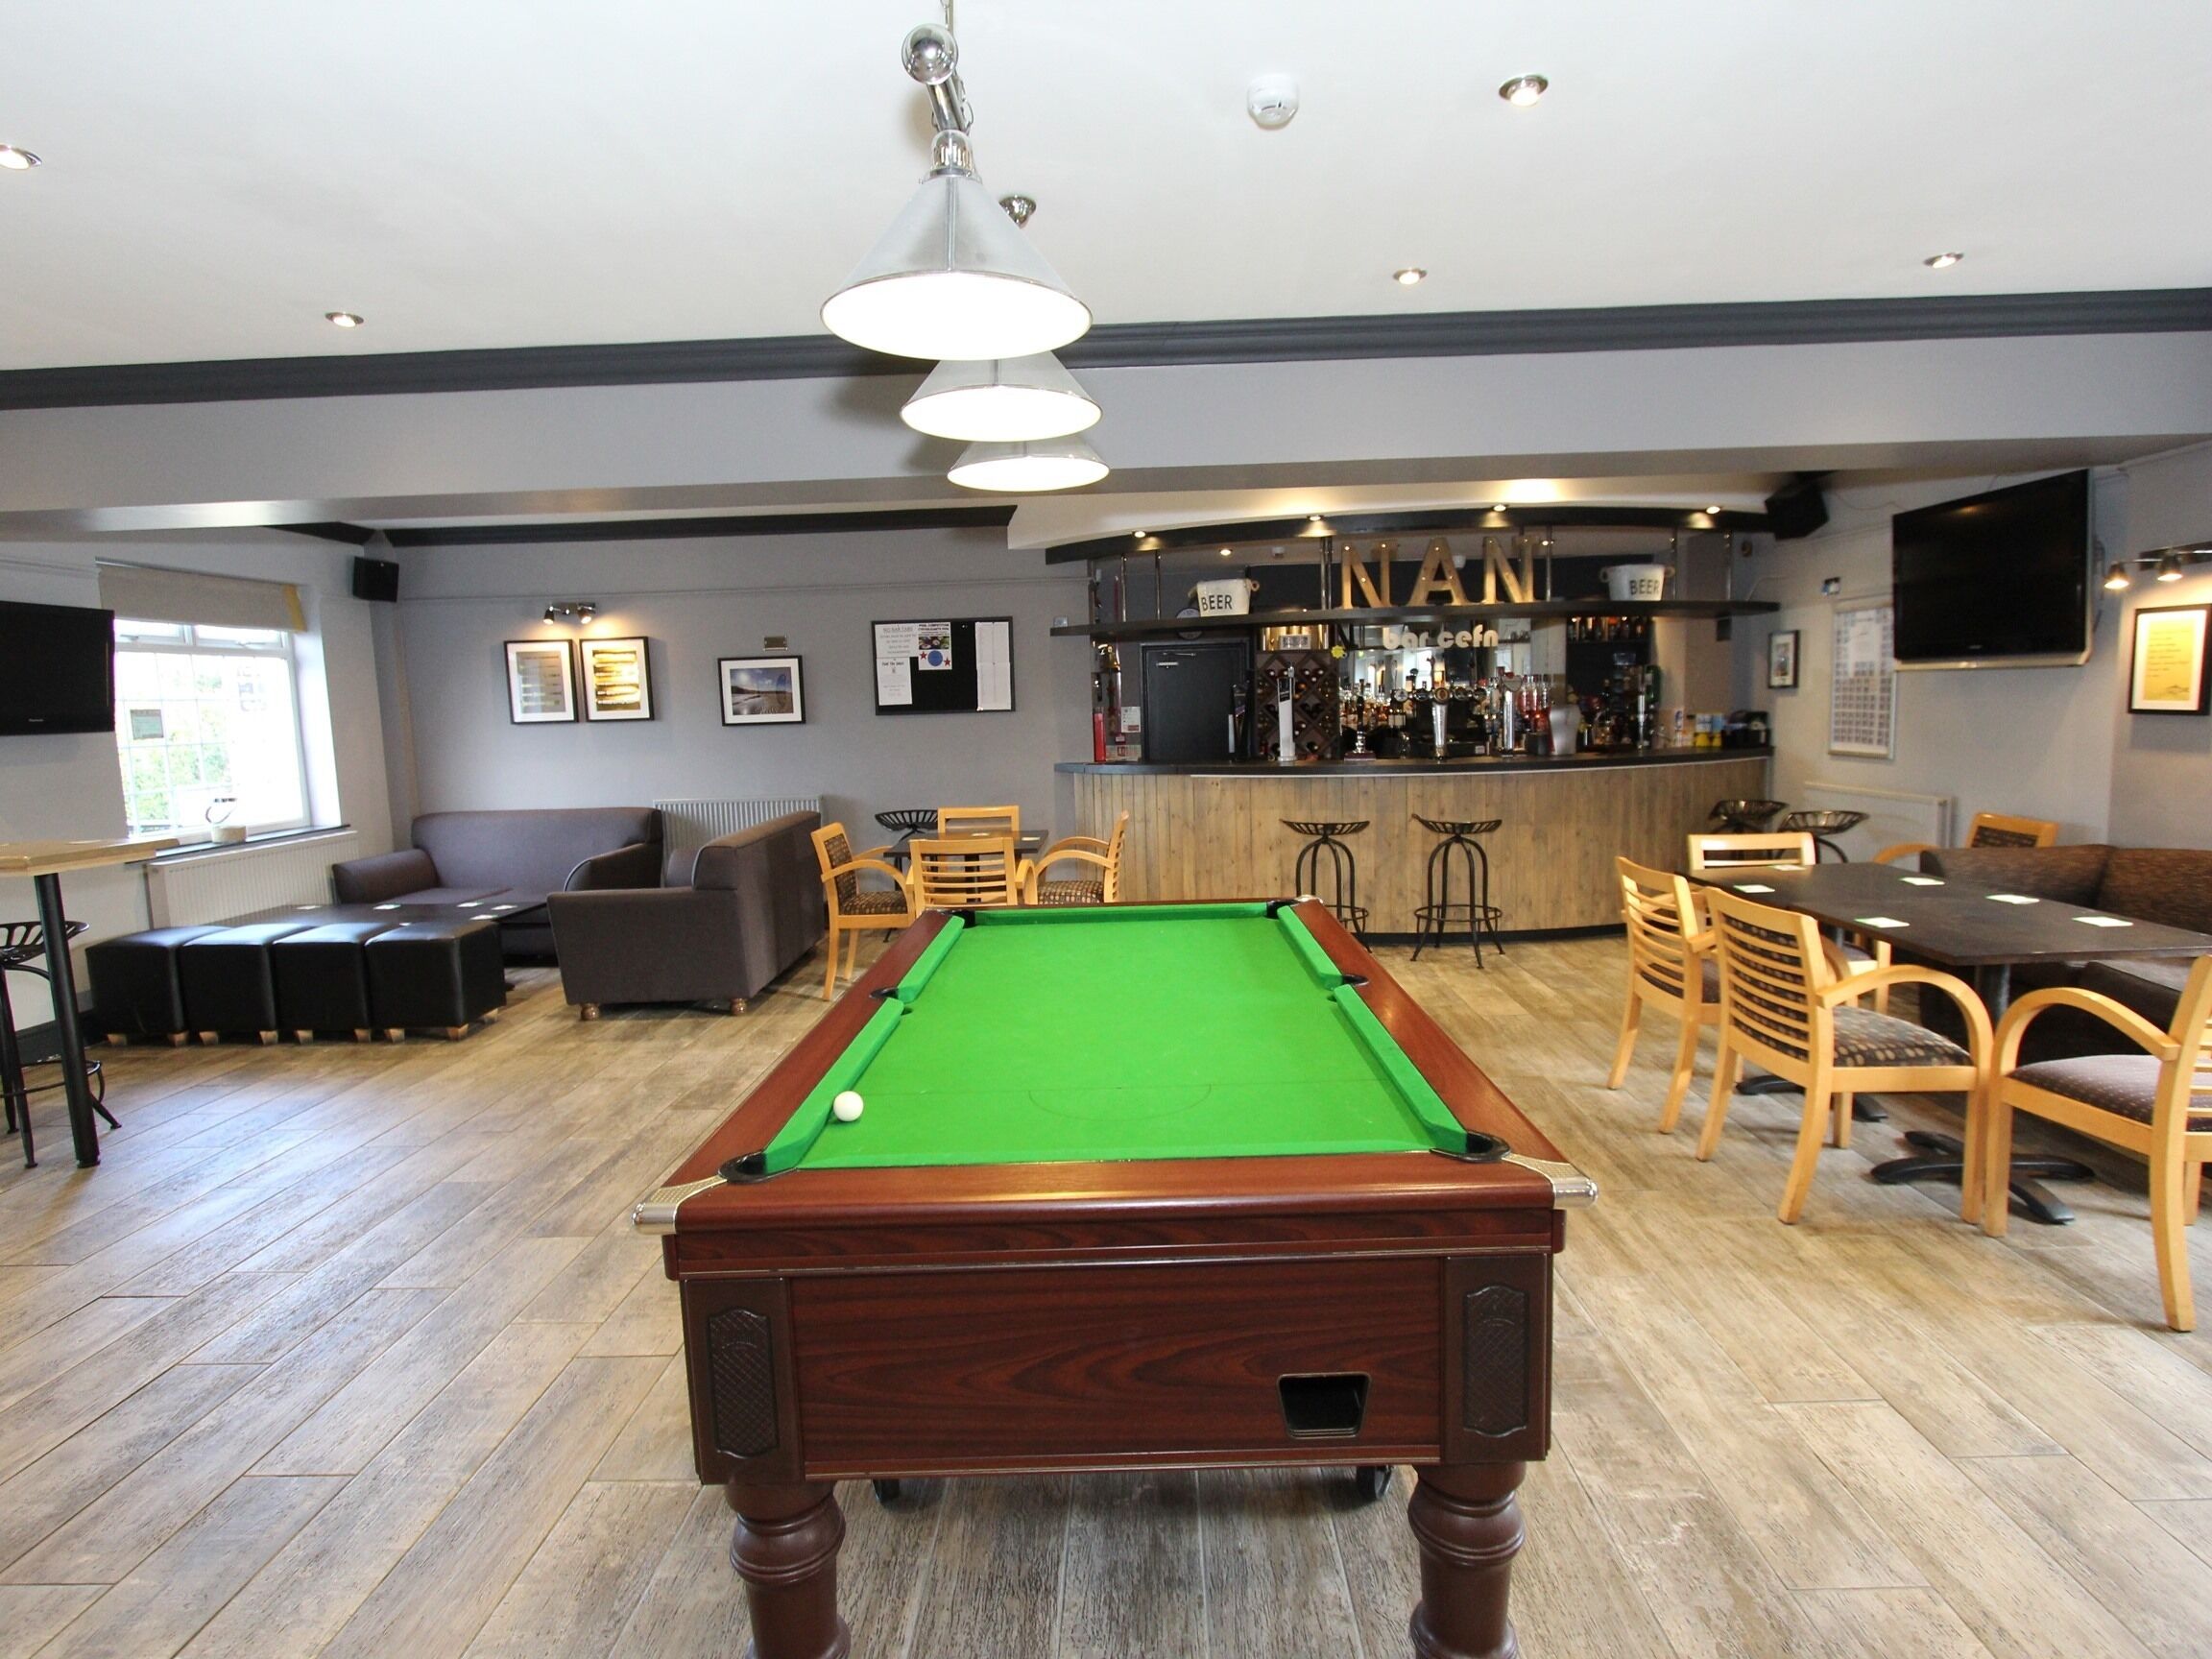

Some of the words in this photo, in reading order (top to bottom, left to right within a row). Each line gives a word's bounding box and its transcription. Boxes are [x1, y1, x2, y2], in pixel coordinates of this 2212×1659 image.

[1337, 537, 1539, 610] NAN
[1629, 579, 1660, 596] BEER
[1201, 594, 1233, 612] BEER
[1382, 627, 1430, 650] bar
[1436, 624, 1499, 649] cefn
